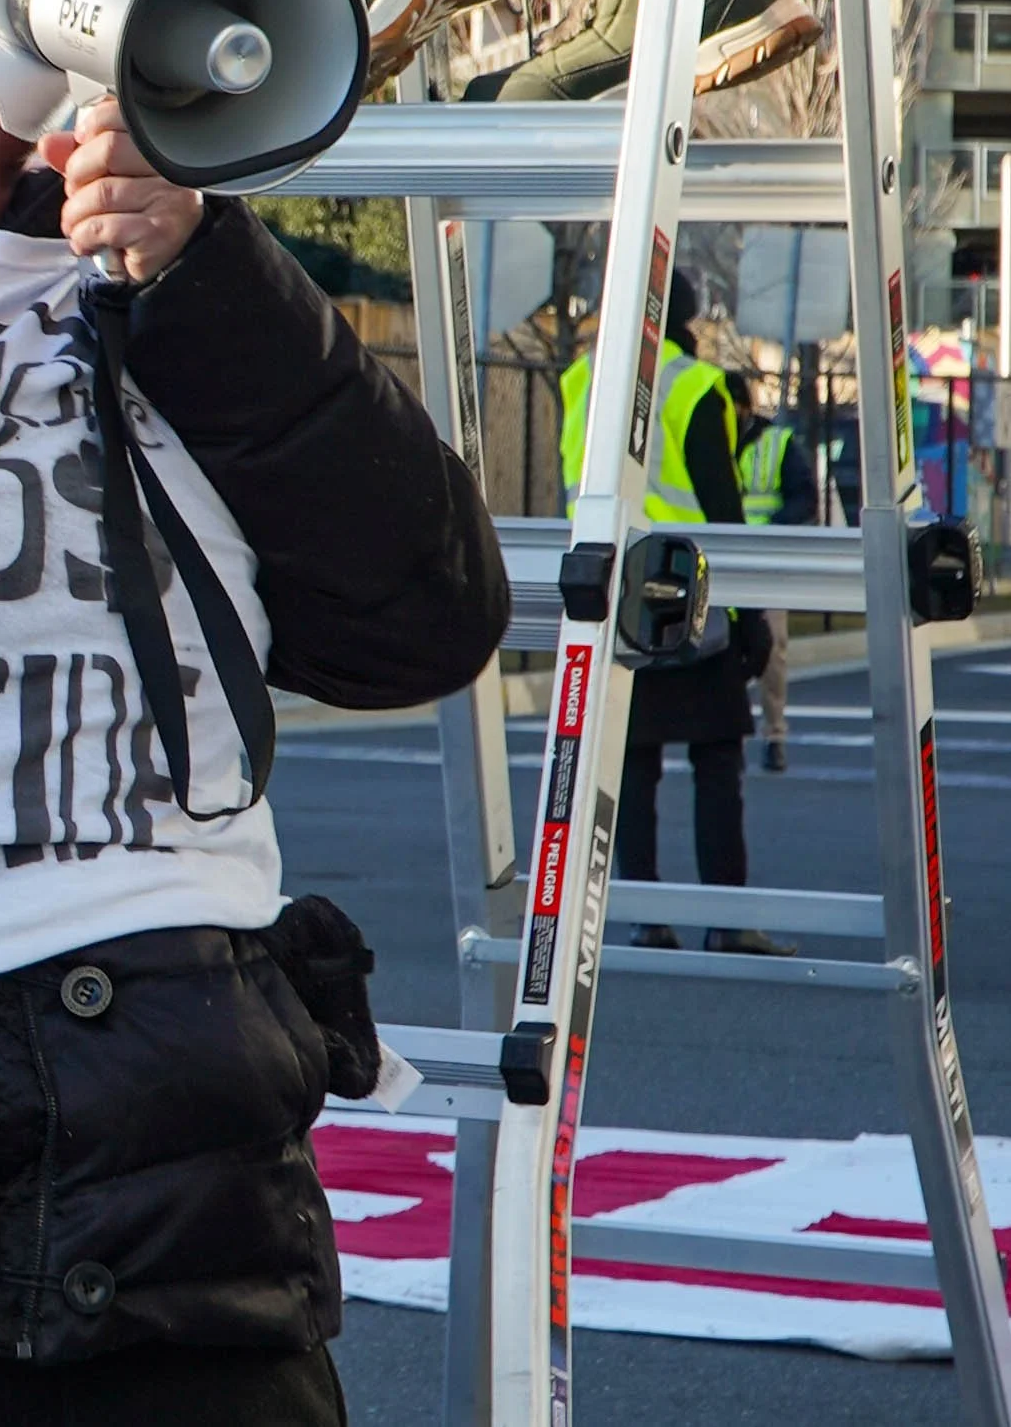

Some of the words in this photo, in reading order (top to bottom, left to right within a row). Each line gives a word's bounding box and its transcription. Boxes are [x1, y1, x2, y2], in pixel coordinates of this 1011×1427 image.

[565, 667, 583, 727] DANGER
[542, 842, 560, 906] PELIGRO
[577, 825, 610, 988] MULTI
[934, 997, 963, 1122] MULTI
